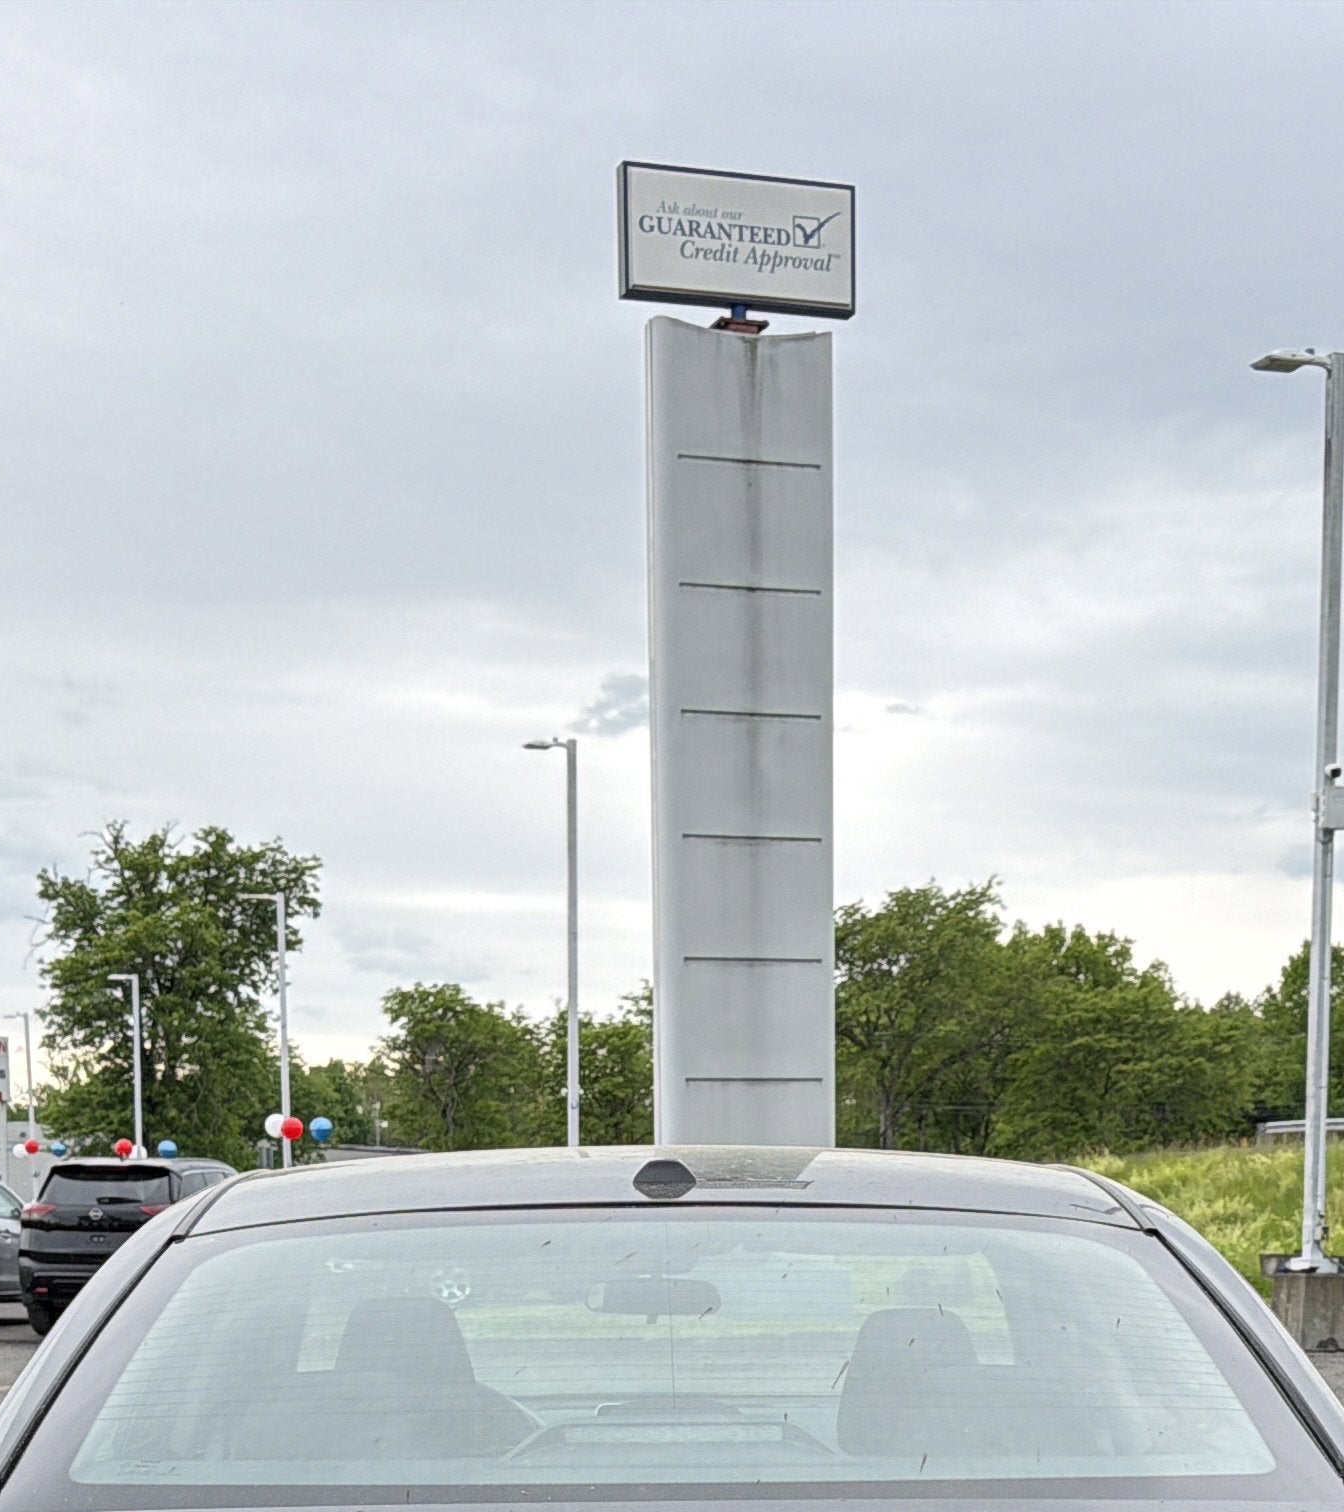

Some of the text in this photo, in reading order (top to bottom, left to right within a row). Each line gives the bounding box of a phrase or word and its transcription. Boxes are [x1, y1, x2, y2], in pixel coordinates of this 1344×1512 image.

[656, 200, 744, 221] Ask about our
[639, 214, 791, 247] GUARANTEED
[680, 239, 832, 273] Credit Approval
